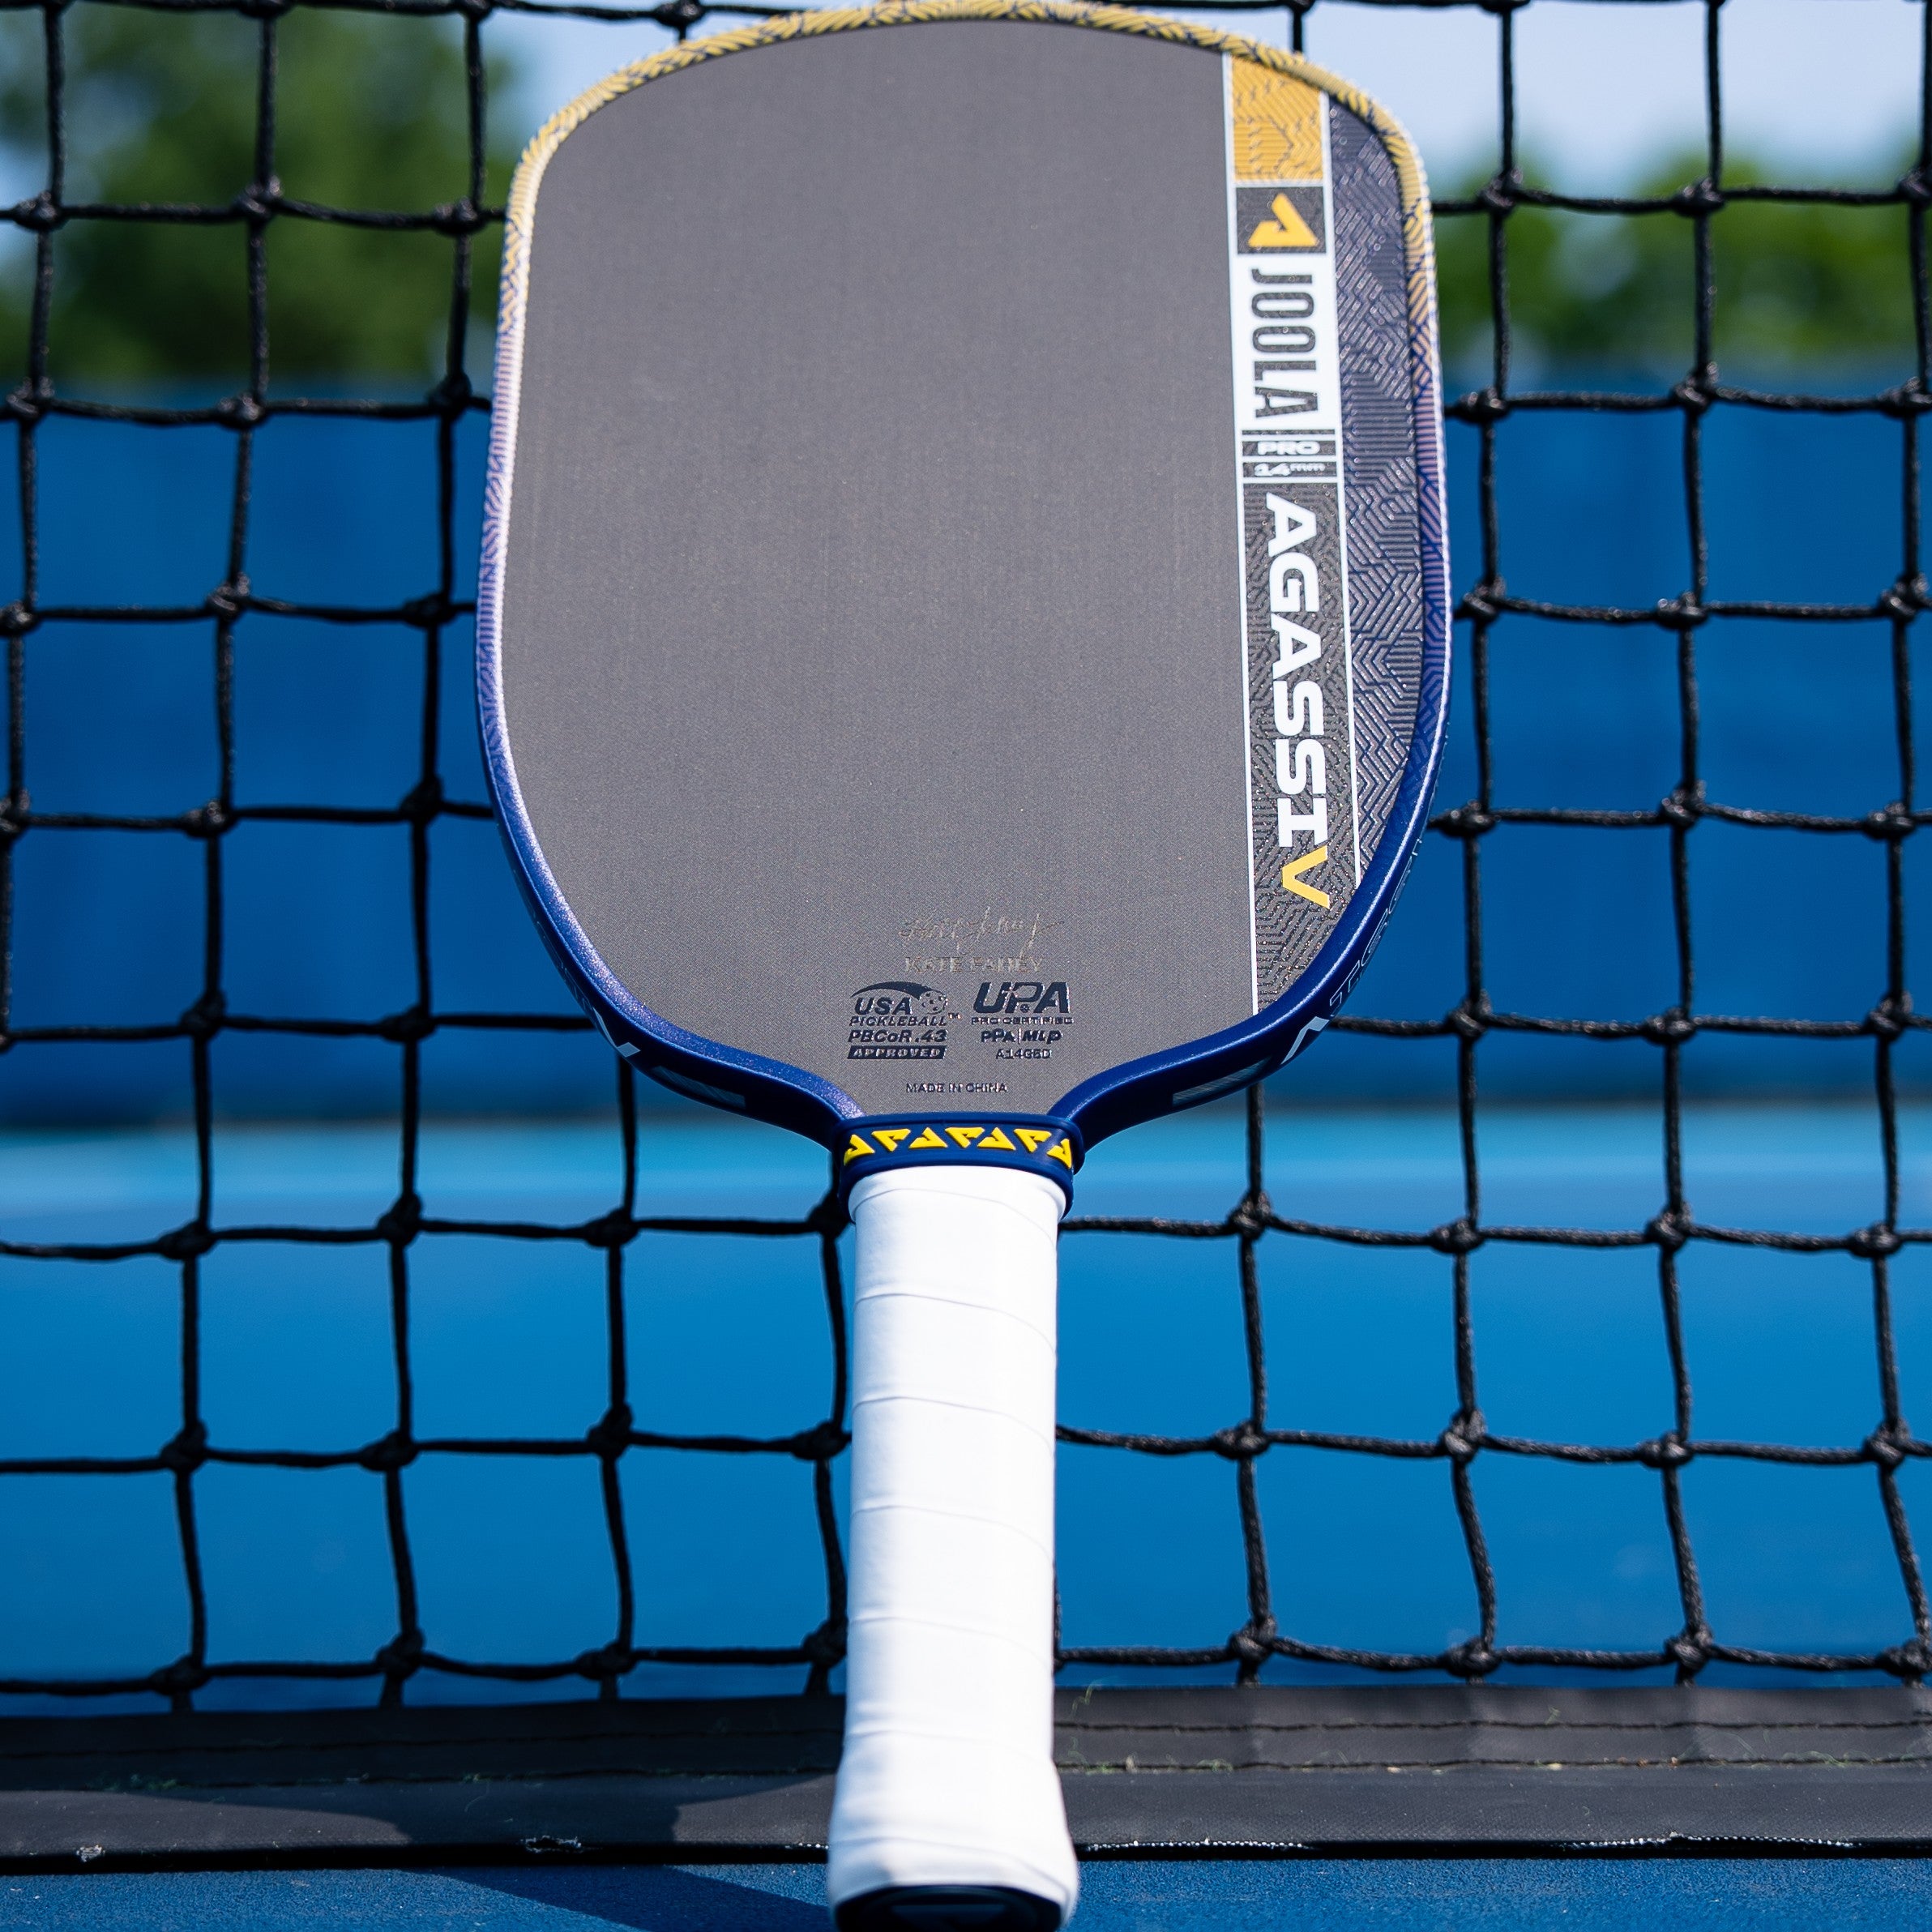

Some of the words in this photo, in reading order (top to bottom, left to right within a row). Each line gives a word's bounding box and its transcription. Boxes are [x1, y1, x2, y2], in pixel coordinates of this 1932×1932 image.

[1251, 268, 1319, 417] JOOLA
[1257, 441, 1321, 455] PRO
[1254, 463, 1326, 477] 14mm
[905, 957, 963, 972] KATE
[970, 957, 1043, 972] FAHEY
[973, 981, 1070, 1013] UPA
[854, 997, 913, 1015] USA
[848, 1015, 947, 1026] PICKLEBALL
[971, 1016, 1002, 1024] PRO
[1002, 1016, 1073, 1024] CERTIFIED
[852, 1048, 941, 1058] APPROVED
[906, 1083, 946, 1093] MADE
[948, 1083, 962, 1093] IN
[965, 1083, 1007, 1093] CHINA
